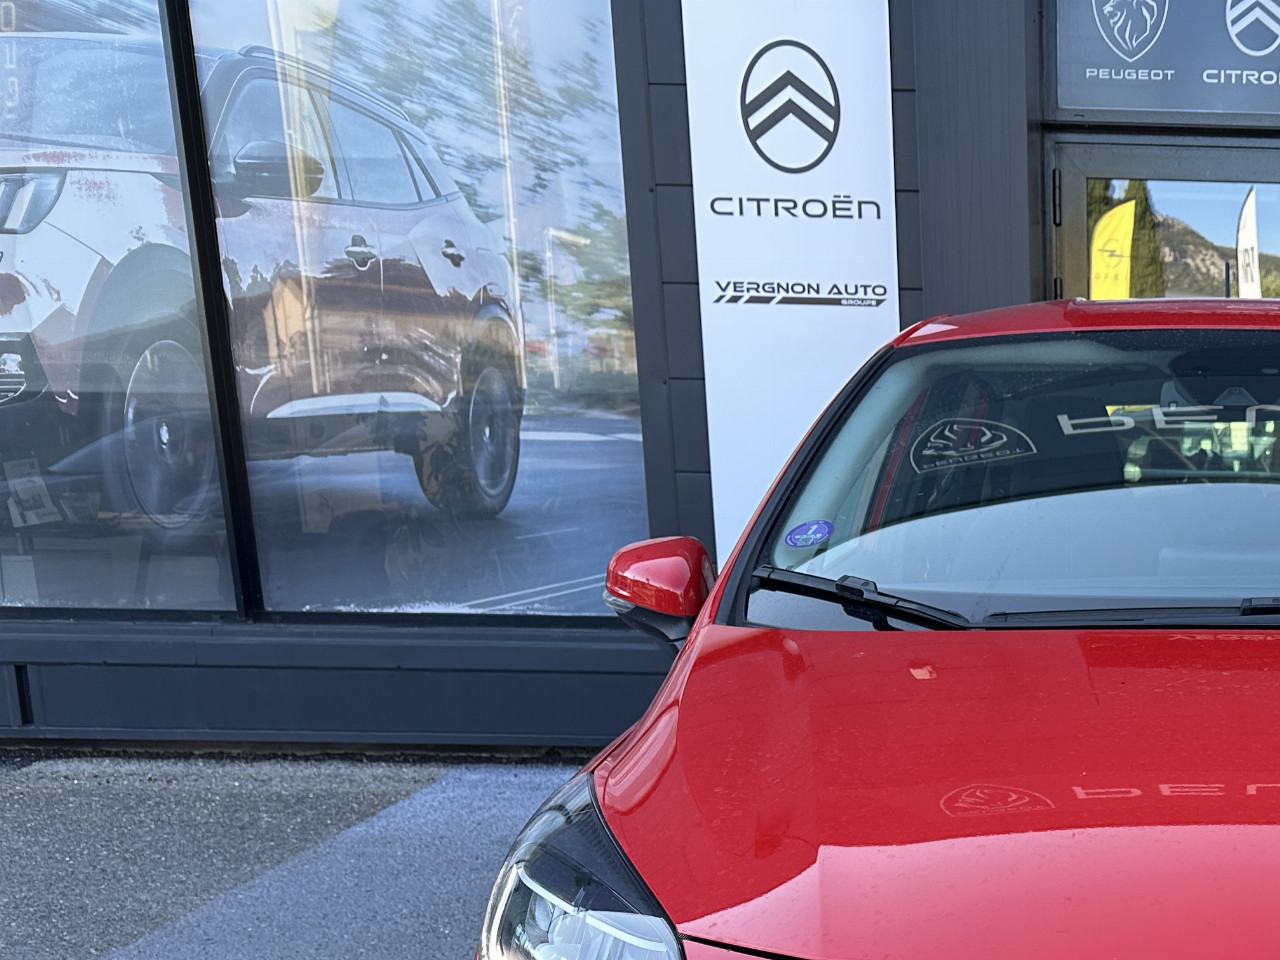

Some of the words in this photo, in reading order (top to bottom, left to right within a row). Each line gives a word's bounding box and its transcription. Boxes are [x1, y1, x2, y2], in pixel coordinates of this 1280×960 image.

[1085, 68, 1176, 81] PEUGEOT
[715, 280, 821, 295] VERGNON
[827, 283, 888, 297] AUTO
